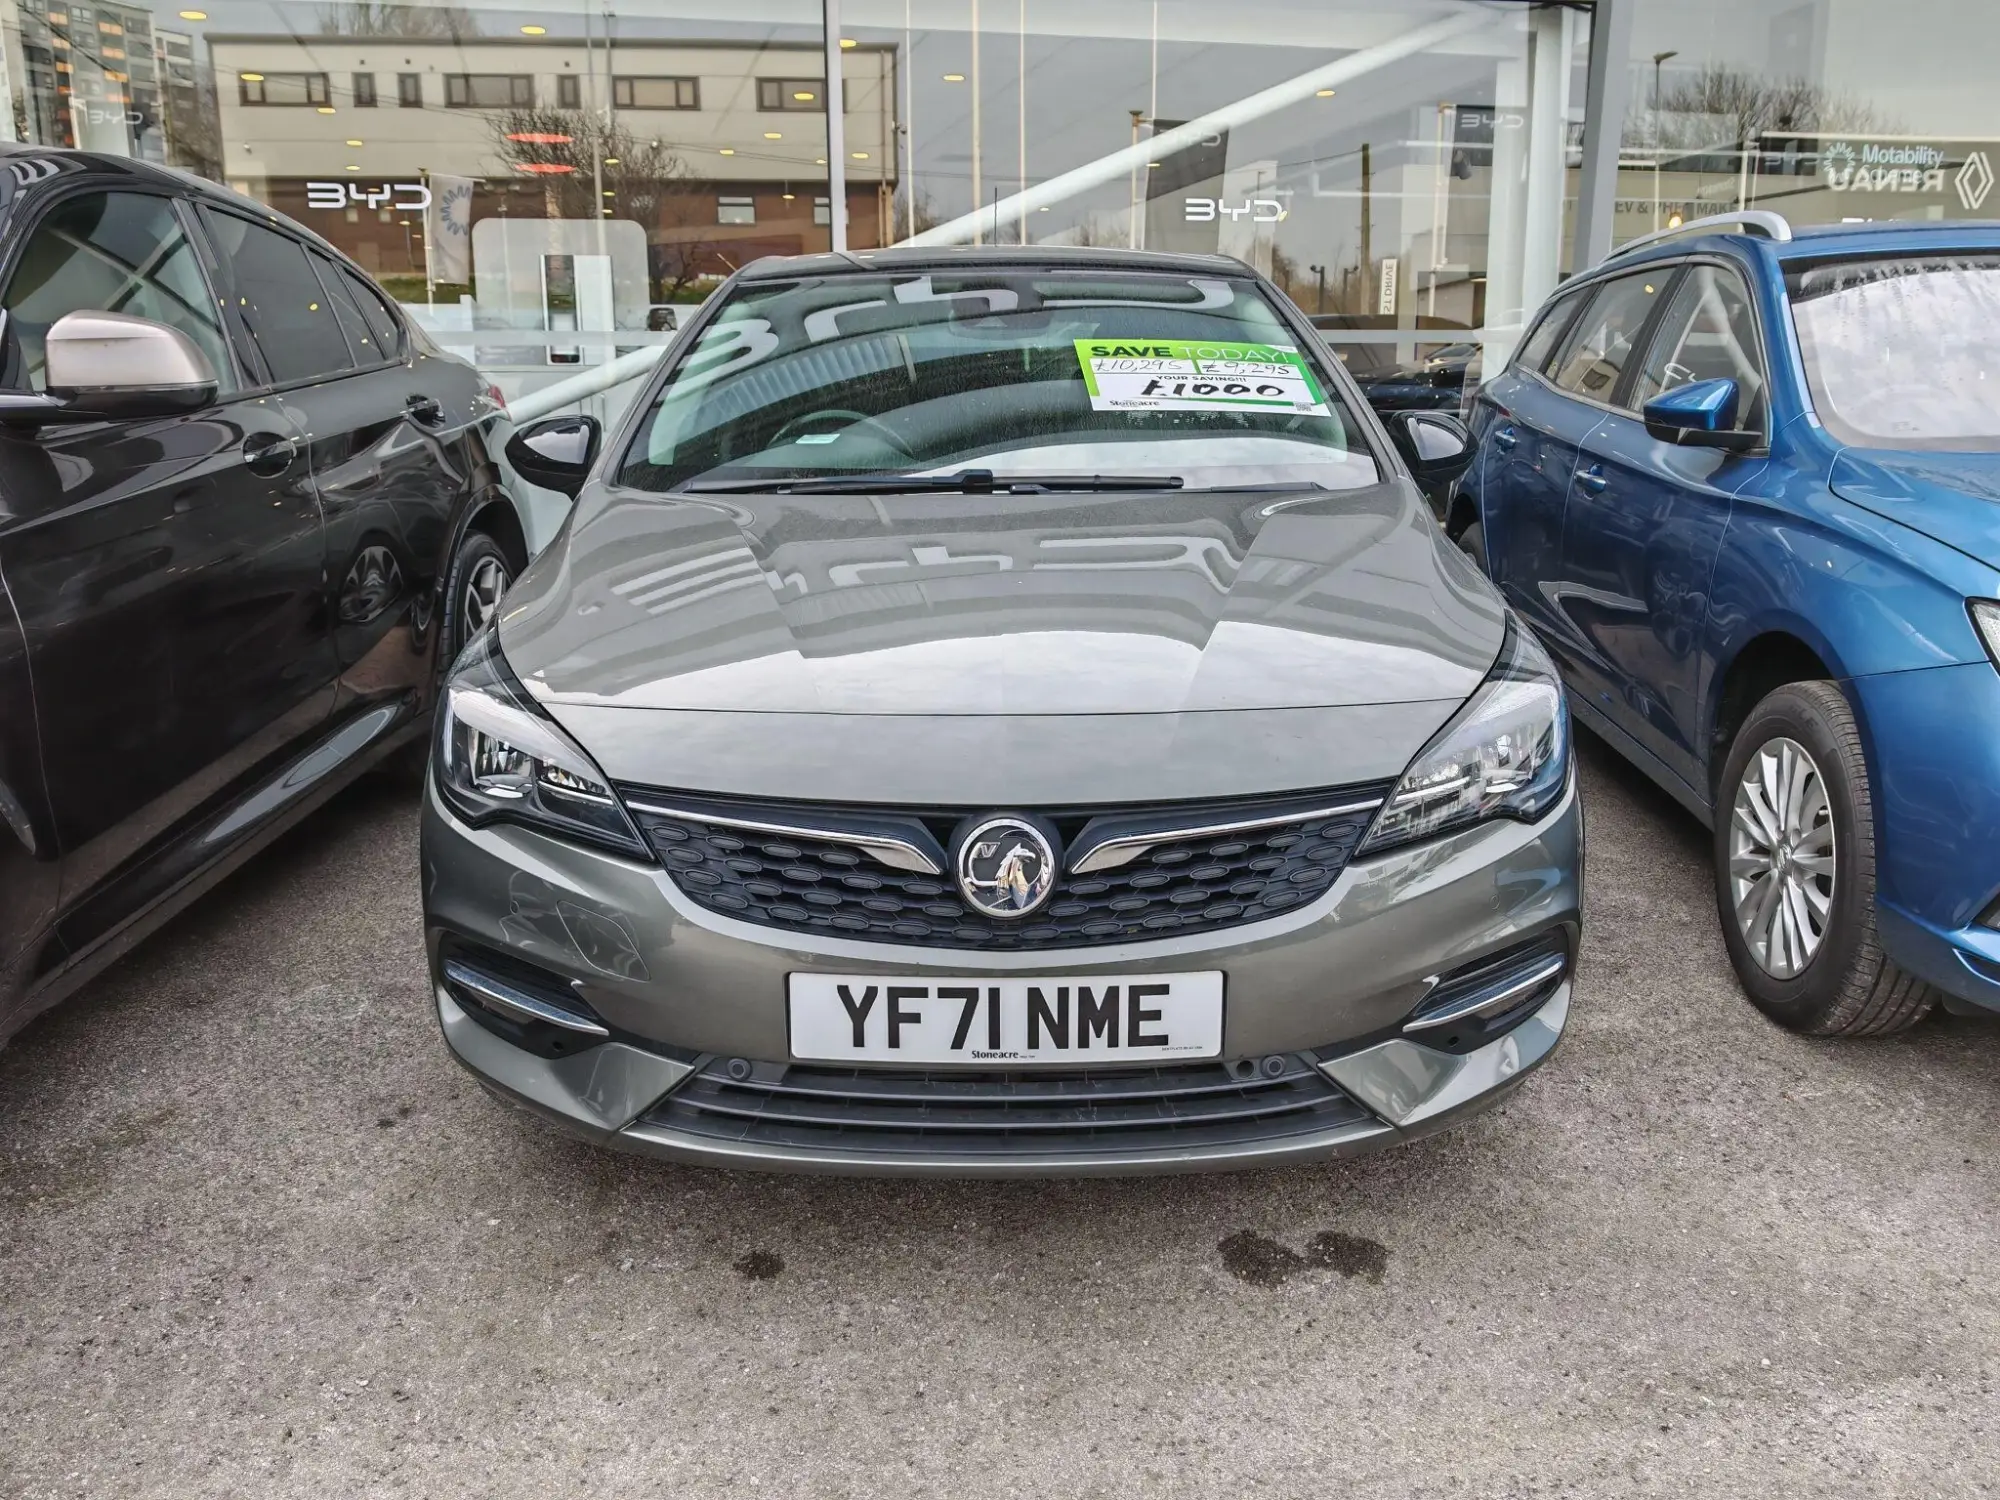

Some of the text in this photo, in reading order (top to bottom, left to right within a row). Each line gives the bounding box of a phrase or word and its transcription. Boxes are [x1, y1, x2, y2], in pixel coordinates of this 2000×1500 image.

[89, 110, 143, 125] BYD
[1461, 113, 1524, 129] BYD
[1862, 144, 1945, 169] Motability
[306, 182, 433, 210] BYD
[1185, 198, 1283, 222] BYD
[1091, 346, 1290, 363] SAVE TODAY!
[1141, 379, 1285, 398] £1000
[836, 984, 1170, 1050] YF71 NME
[971, 1050, 1019, 1060] Stoneacre
